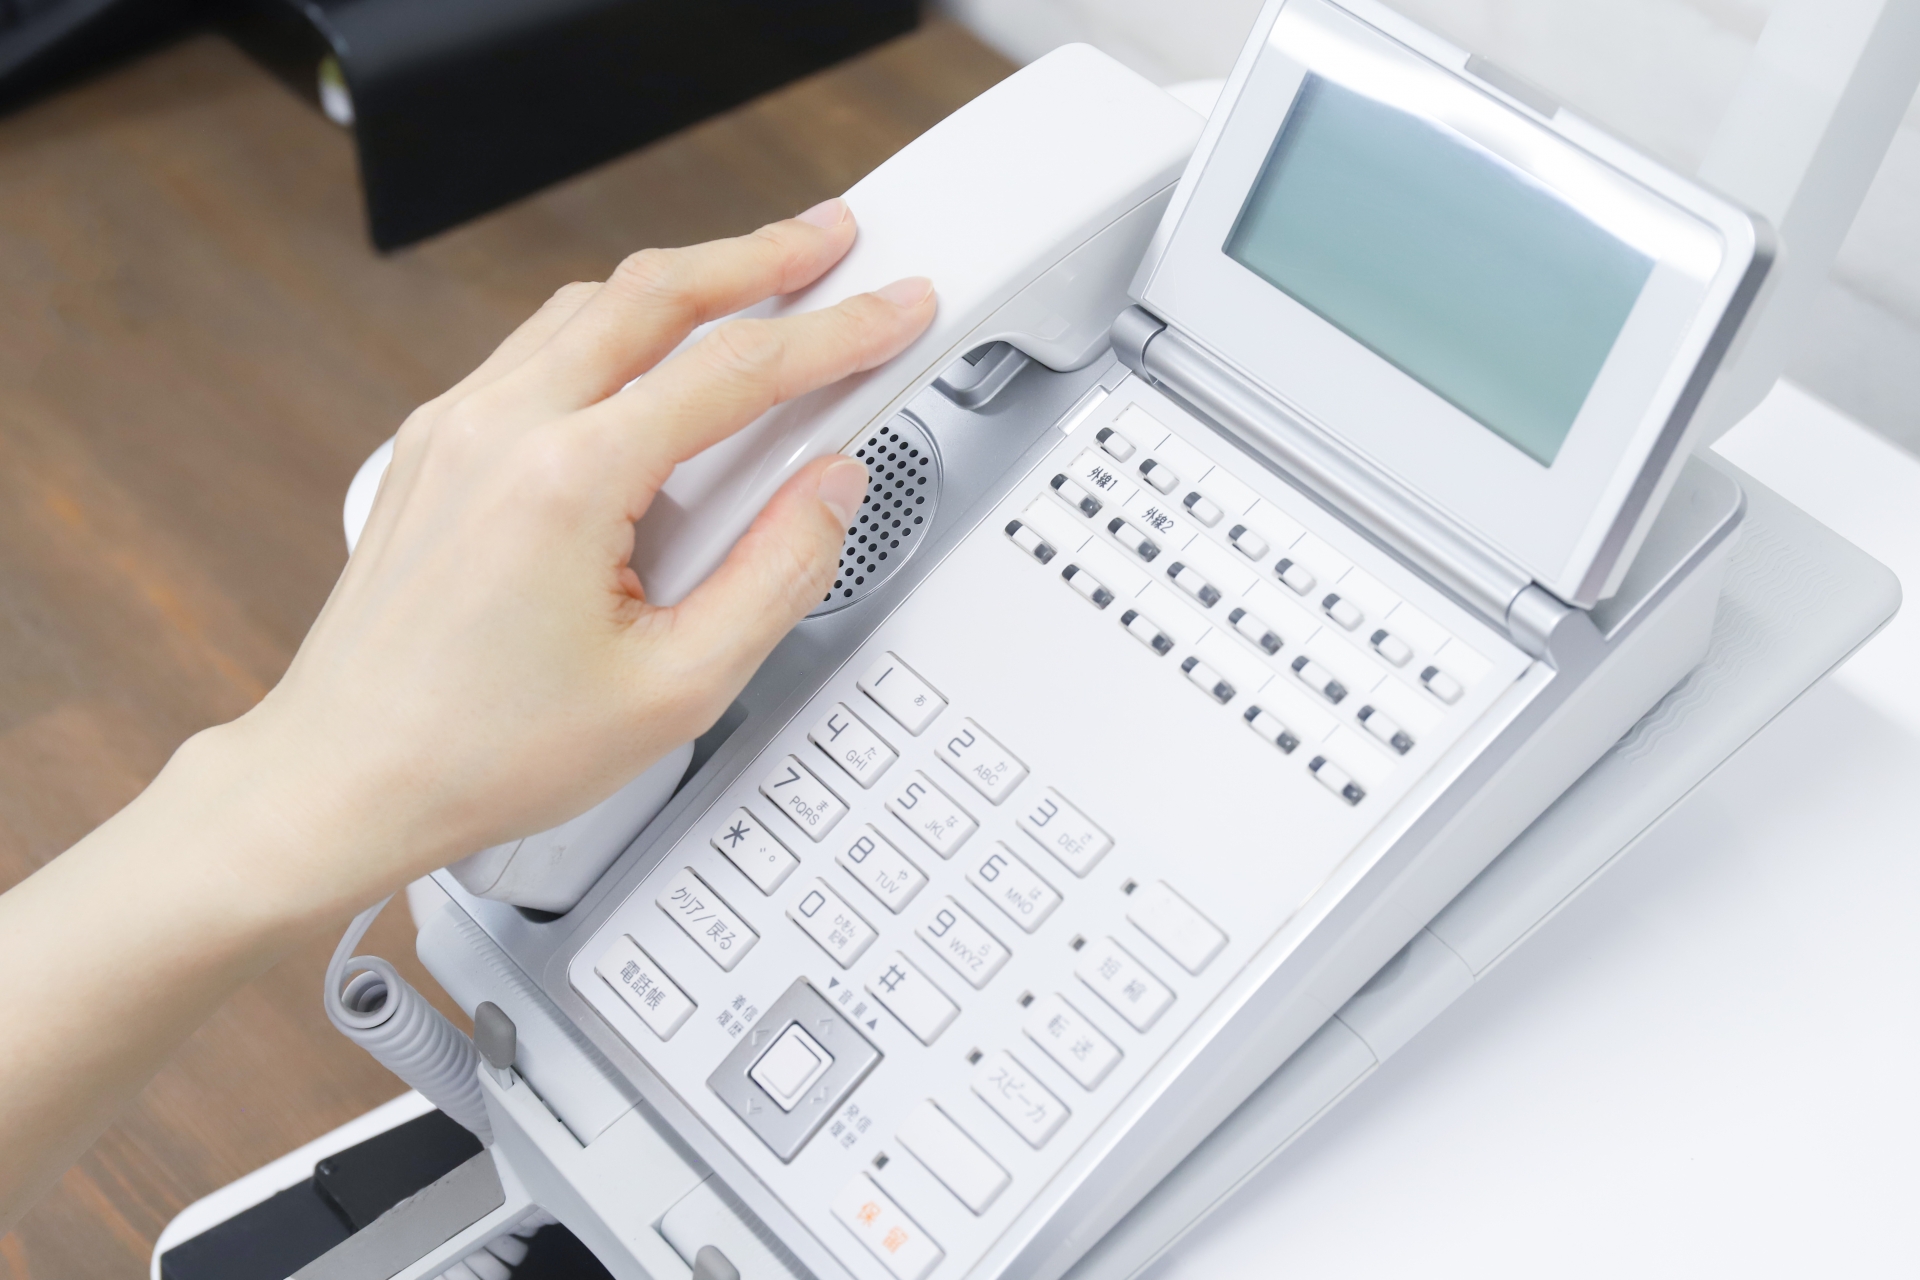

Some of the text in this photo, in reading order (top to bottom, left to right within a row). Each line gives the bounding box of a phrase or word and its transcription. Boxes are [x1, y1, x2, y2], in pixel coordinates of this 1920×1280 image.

[1087, 466, 1118, 491] 外線1
[1141, 506, 1174, 534] 外線2
[874, 667, 894, 687] 1
[913, 694, 927, 707] あ
[827, 713, 850, 742] 4
[864, 746, 877, 760] た
[947, 729, 976, 758] 2
[845, 749, 868, 772] GHI
[973, 763, 999, 786] ABC
[994, 761, 1008, 773] か
[773, 766, 801, 788] 7
[816, 800, 829, 813] ま
[897, 782, 926, 810] 5
[789, 795, 820, 826] PQRS
[945, 815, 959, 828] な
[1028, 798, 1058, 827] 3
[924, 820, 945, 840] JKL
[1080, 832, 1094, 845] さ
[848, 835, 876, 864] 8
[1057, 833, 1085, 856] DEF
[875, 869, 900, 894] TUV
[897, 869, 908, 880] や
[978, 854, 1008, 882] 6
[798, 890, 826, 918] 0
[1004, 887, 1034, 915] MNO
[1028, 887, 1042, 900] は
[833, 913, 856, 938] わをん
[927, 909, 956, 938] 9
[827, 929, 849, 950] 記号
[980, 944, 992, 957] ら
[949, 937, 985, 972] WXYZ
[619, 959, 667, 1011] 電話帳
[731, 994, 759, 1023] 着信
[716, 1010, 745, 1039] 履歴
[1047, 1013, 1094, 1062] 転送
[988, 1067, 1047, 1123] スピーカ
[846, 1103, 873, 1134] 発信
[828, 1120, 858, 1150] 履歴
[856, 1201, 909, 1254] 保留
